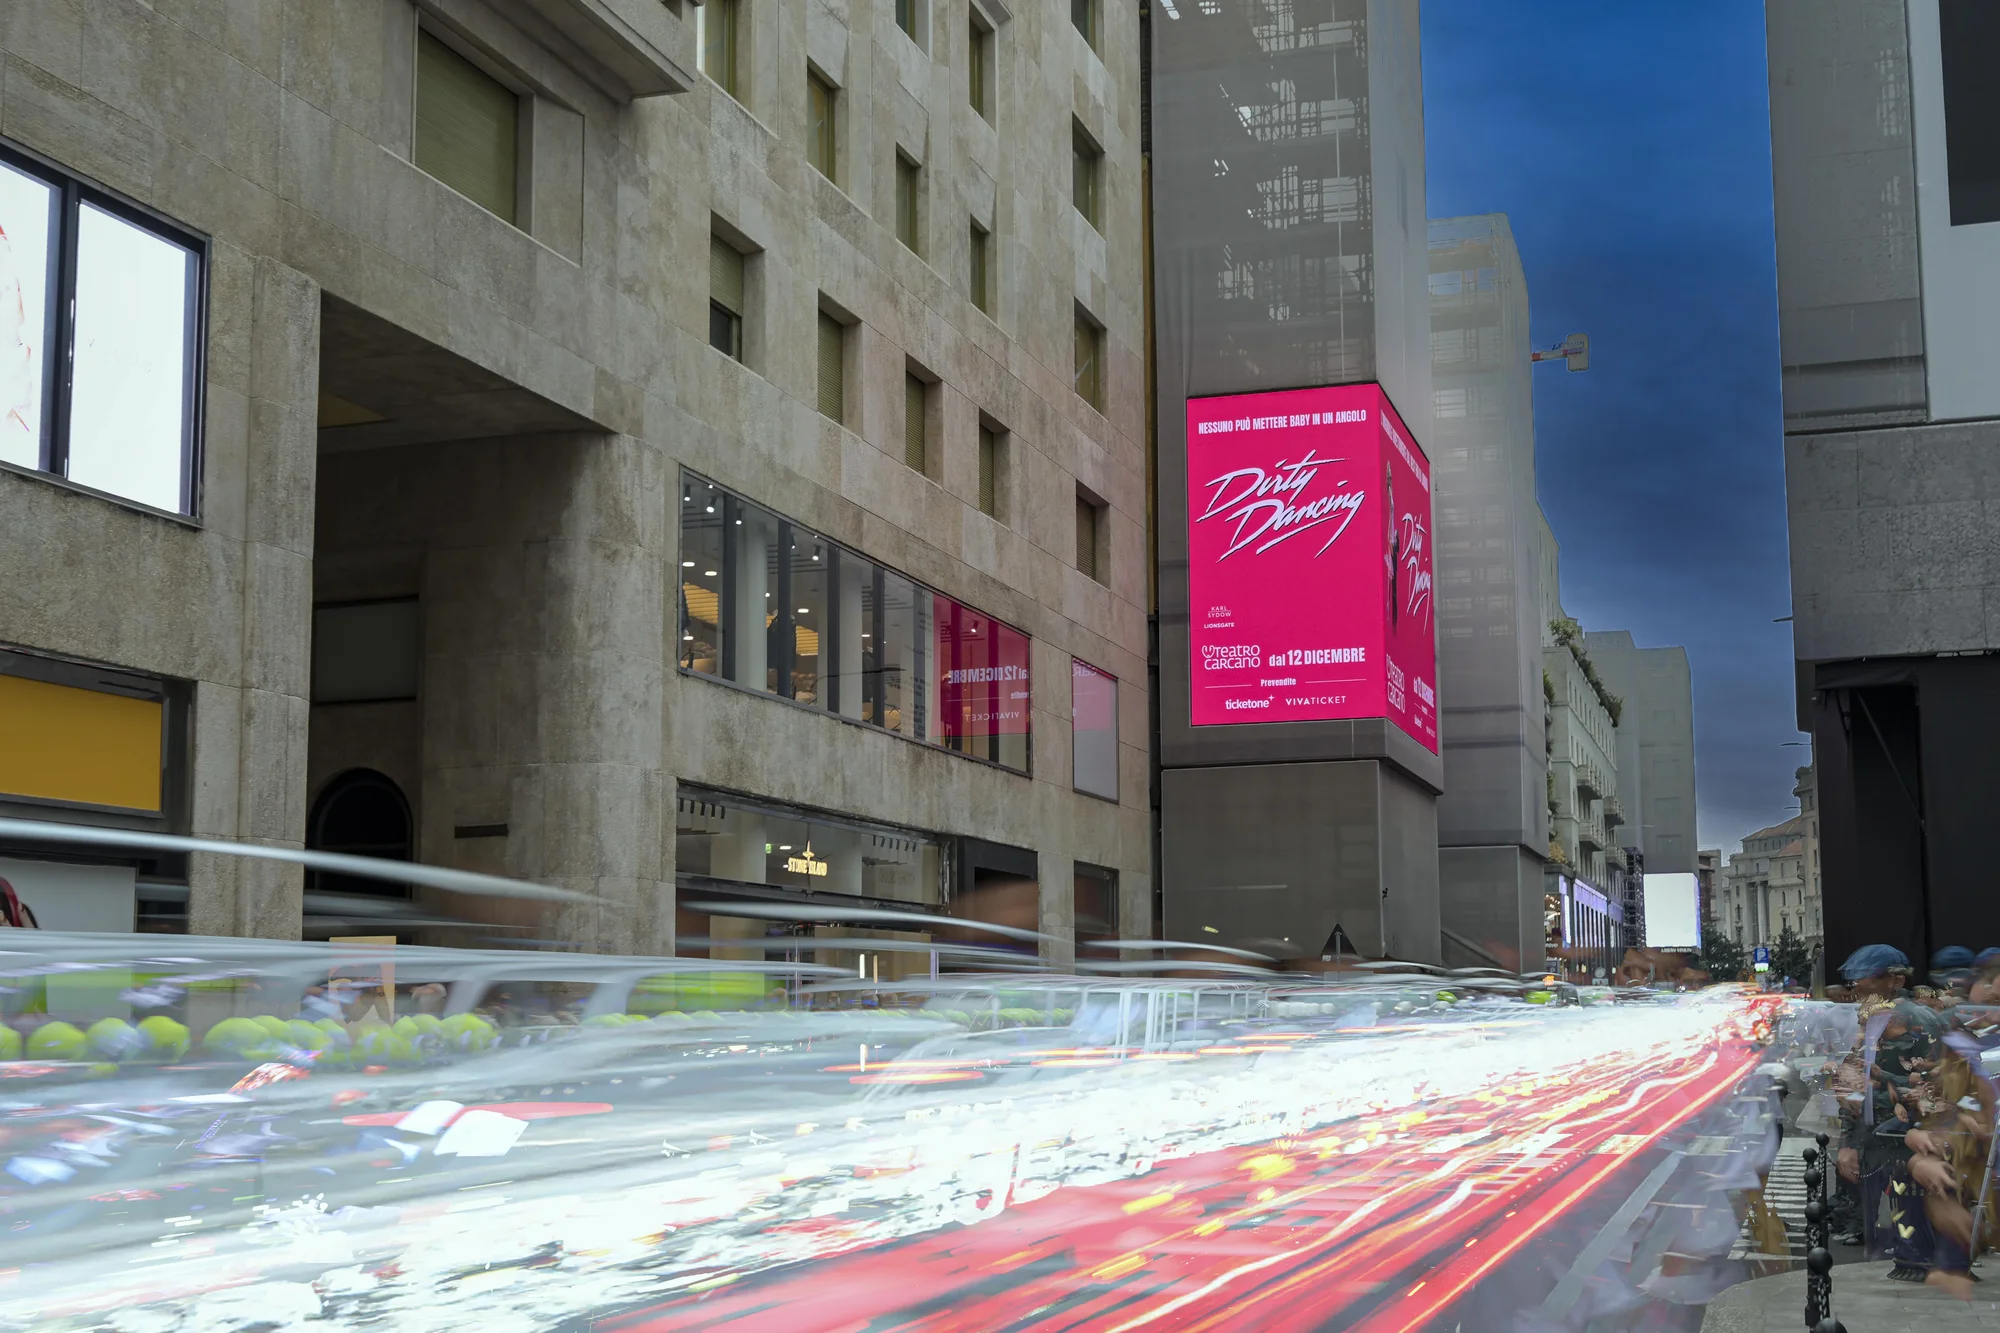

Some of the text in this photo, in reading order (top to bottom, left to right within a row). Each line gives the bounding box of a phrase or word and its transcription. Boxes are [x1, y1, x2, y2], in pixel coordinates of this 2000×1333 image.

[1198, 409, 1367, 434] NESSUNO PUÒ METTERE BABY IN UN ANGOLO
[1194, 449, 1351, 523] Dirty
[1215, 480, 1366, 564] Dancing
[1269, 647, 1366, 667] dal 12 DICEMBRE
[1260, 677, 1297, 687] Prevendite
[1225, 698, 1270, 710] ticketone
[1285, 695, 1347, 706] VIVATICKET
[1756, 949, 1766, 961] P
